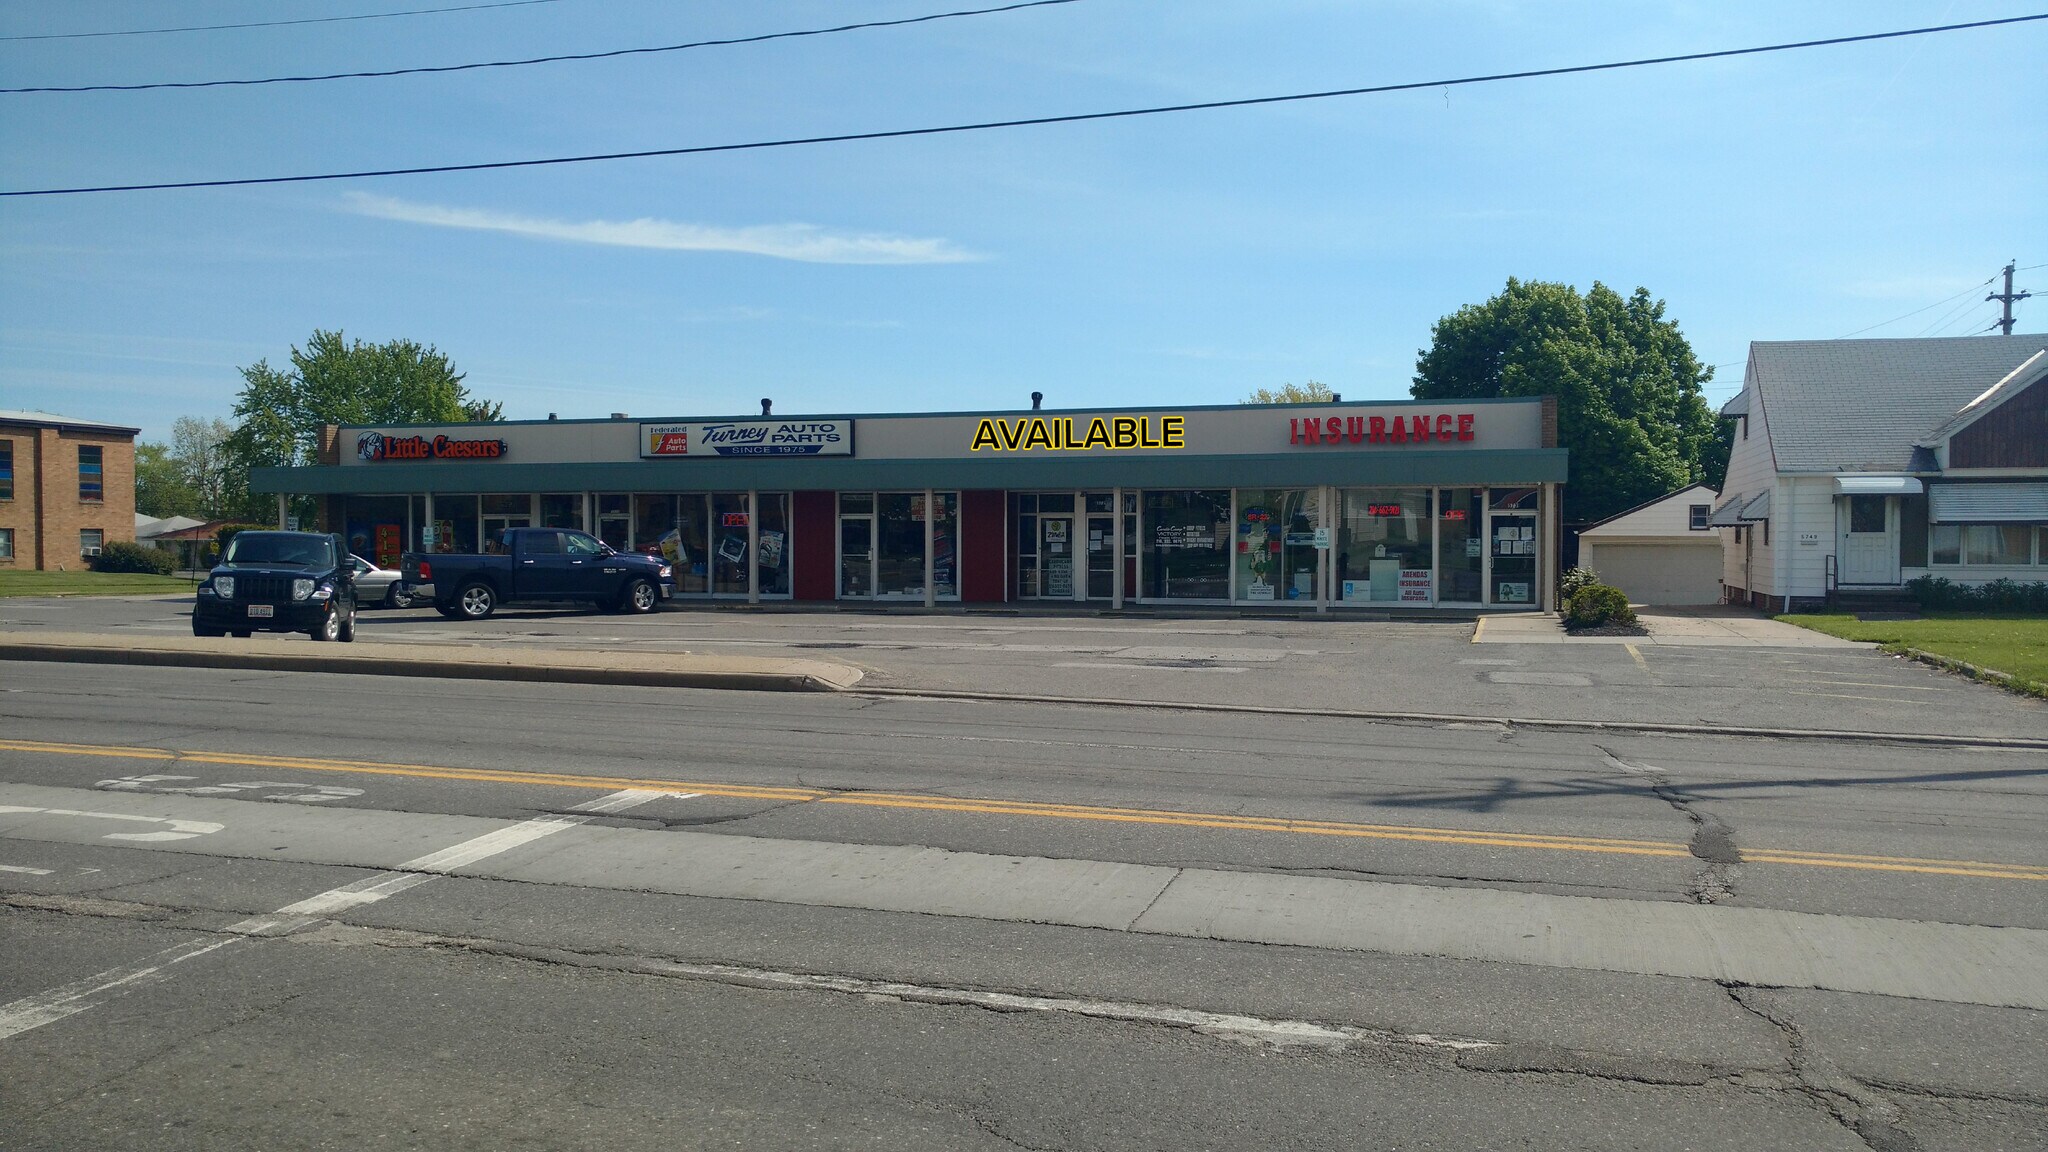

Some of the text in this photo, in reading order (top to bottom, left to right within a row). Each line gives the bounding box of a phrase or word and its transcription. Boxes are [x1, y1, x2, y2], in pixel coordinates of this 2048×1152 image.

[777, 424, 836, 433] AUTO
[1290, 414, 1475, 445] INSURANCE
[701, 424, 769, 444] Turney
[771, 433, 841, 443] PARTS
[668, 437, 686, 445] Auto
[384, 434, 500, 459] Little Caesars
[666, 444, 687, 452] Parts
[732, 445, 806, 454] SINCE 1975
[381, 555, 389, 566] 5
